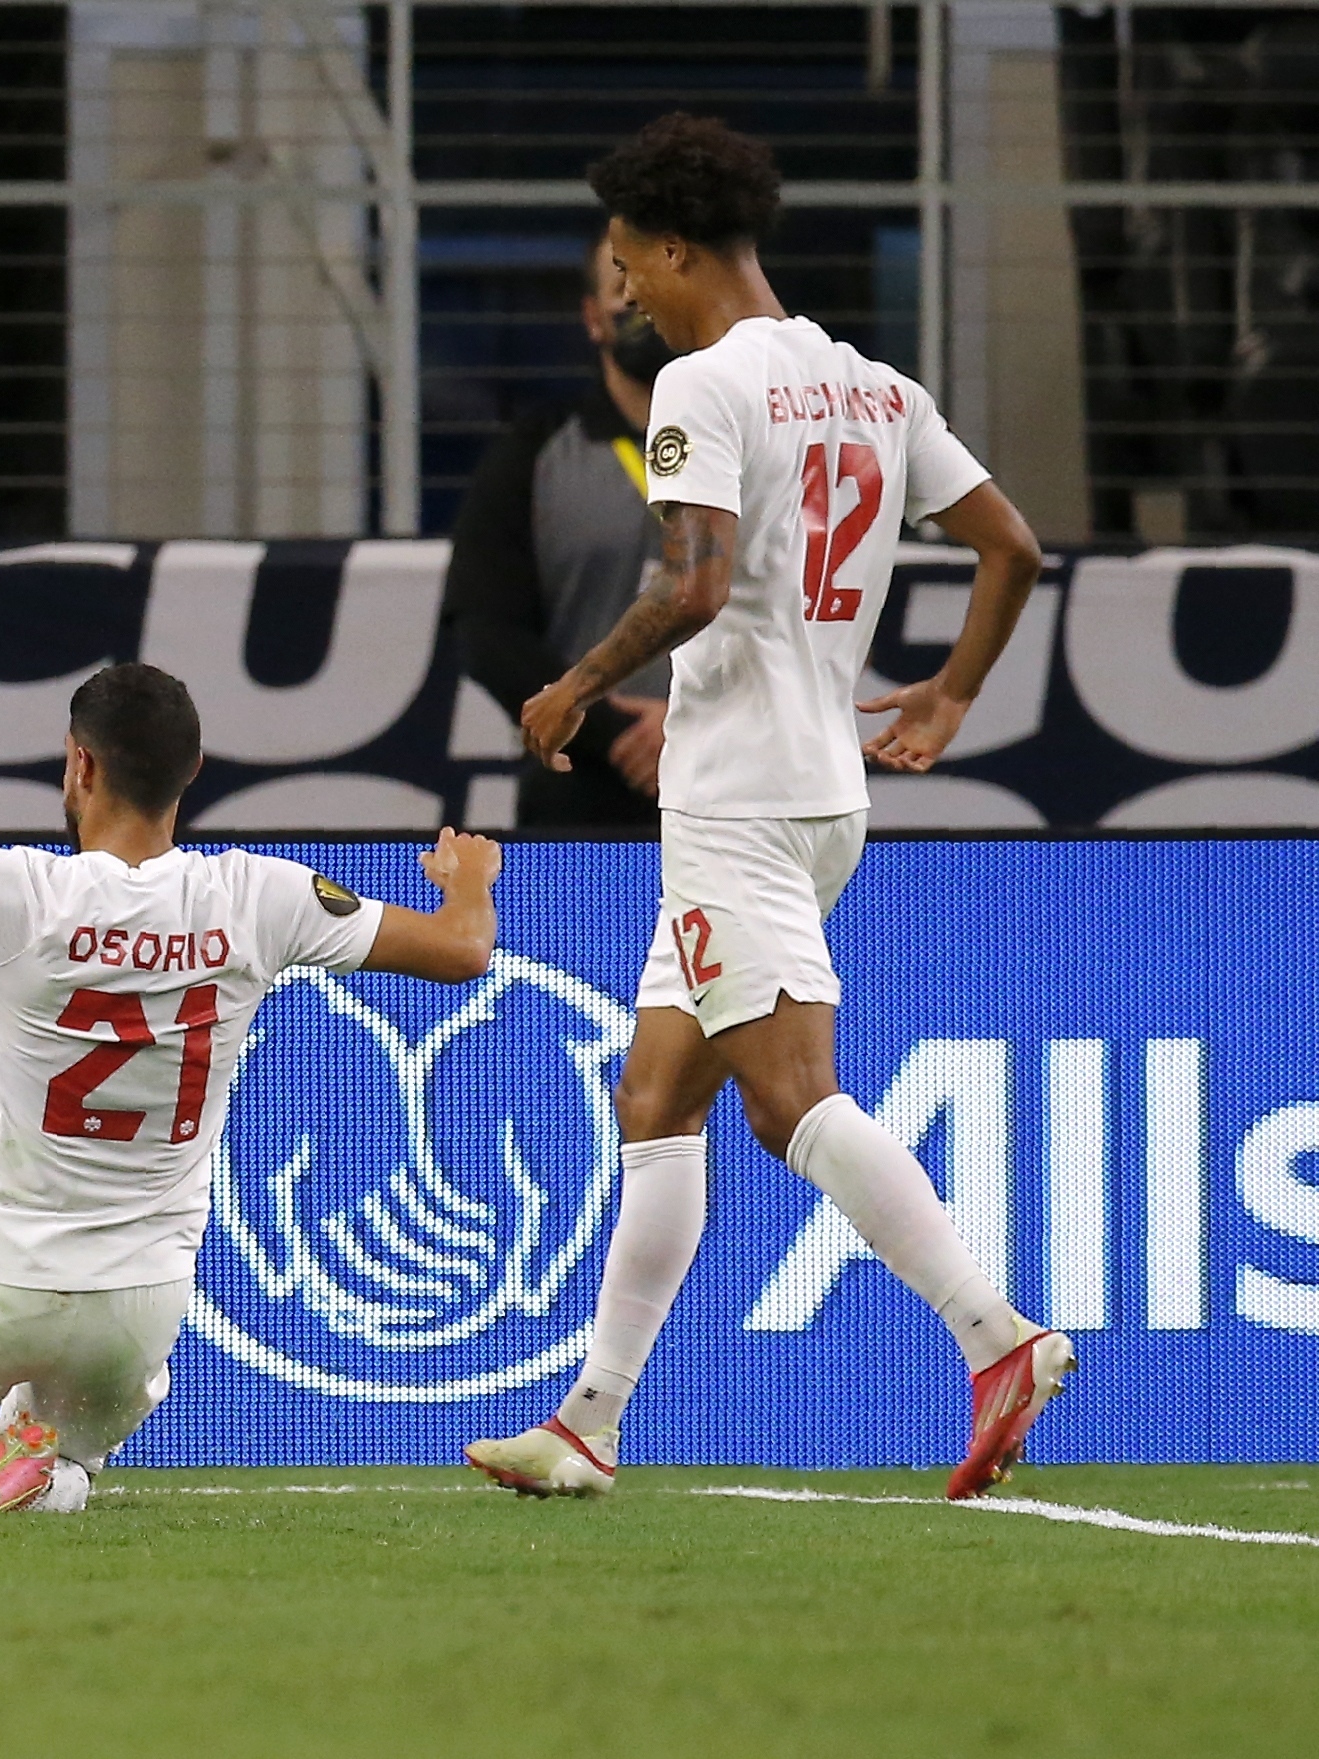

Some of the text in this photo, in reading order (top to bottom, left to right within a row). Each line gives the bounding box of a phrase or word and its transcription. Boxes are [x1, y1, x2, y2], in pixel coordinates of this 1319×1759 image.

[801, 443, 883, 622] 12
[68, 926, 230, 972] OSORIO
[672, 908, 722, 991] 12
[40, 984, 219, 1144] 21
